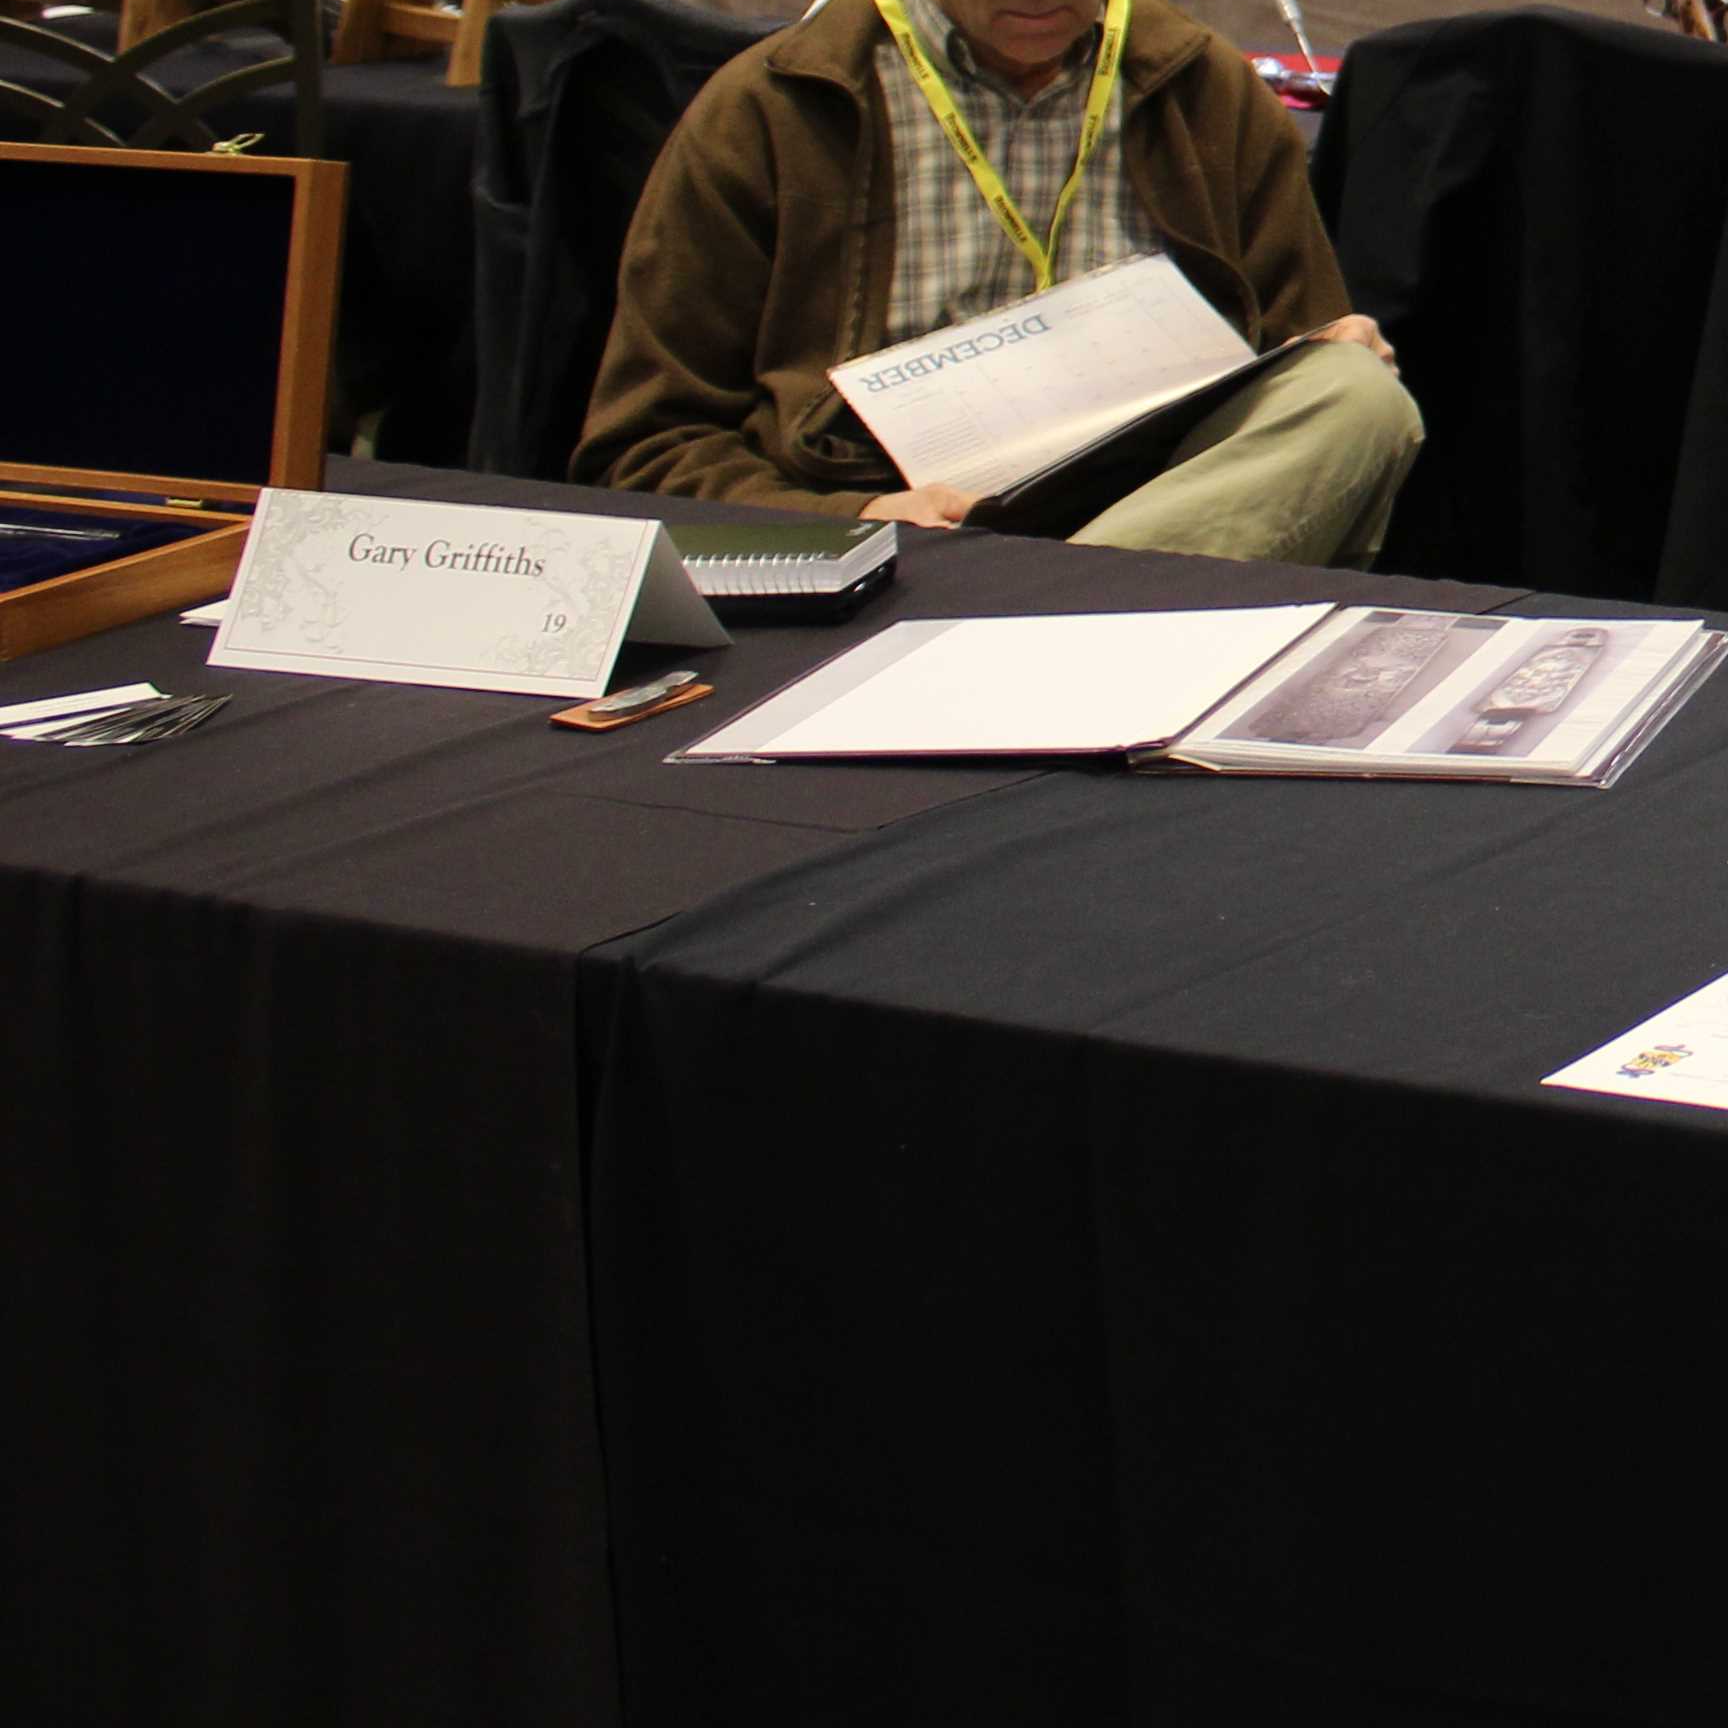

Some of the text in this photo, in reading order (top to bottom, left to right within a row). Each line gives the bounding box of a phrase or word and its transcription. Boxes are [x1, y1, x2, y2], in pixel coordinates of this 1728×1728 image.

[858, 312, 1053, 395] DECEMBER
[347, 533, 546, 578] Gary Griffiths
[541, 613, 568, 634] 19
